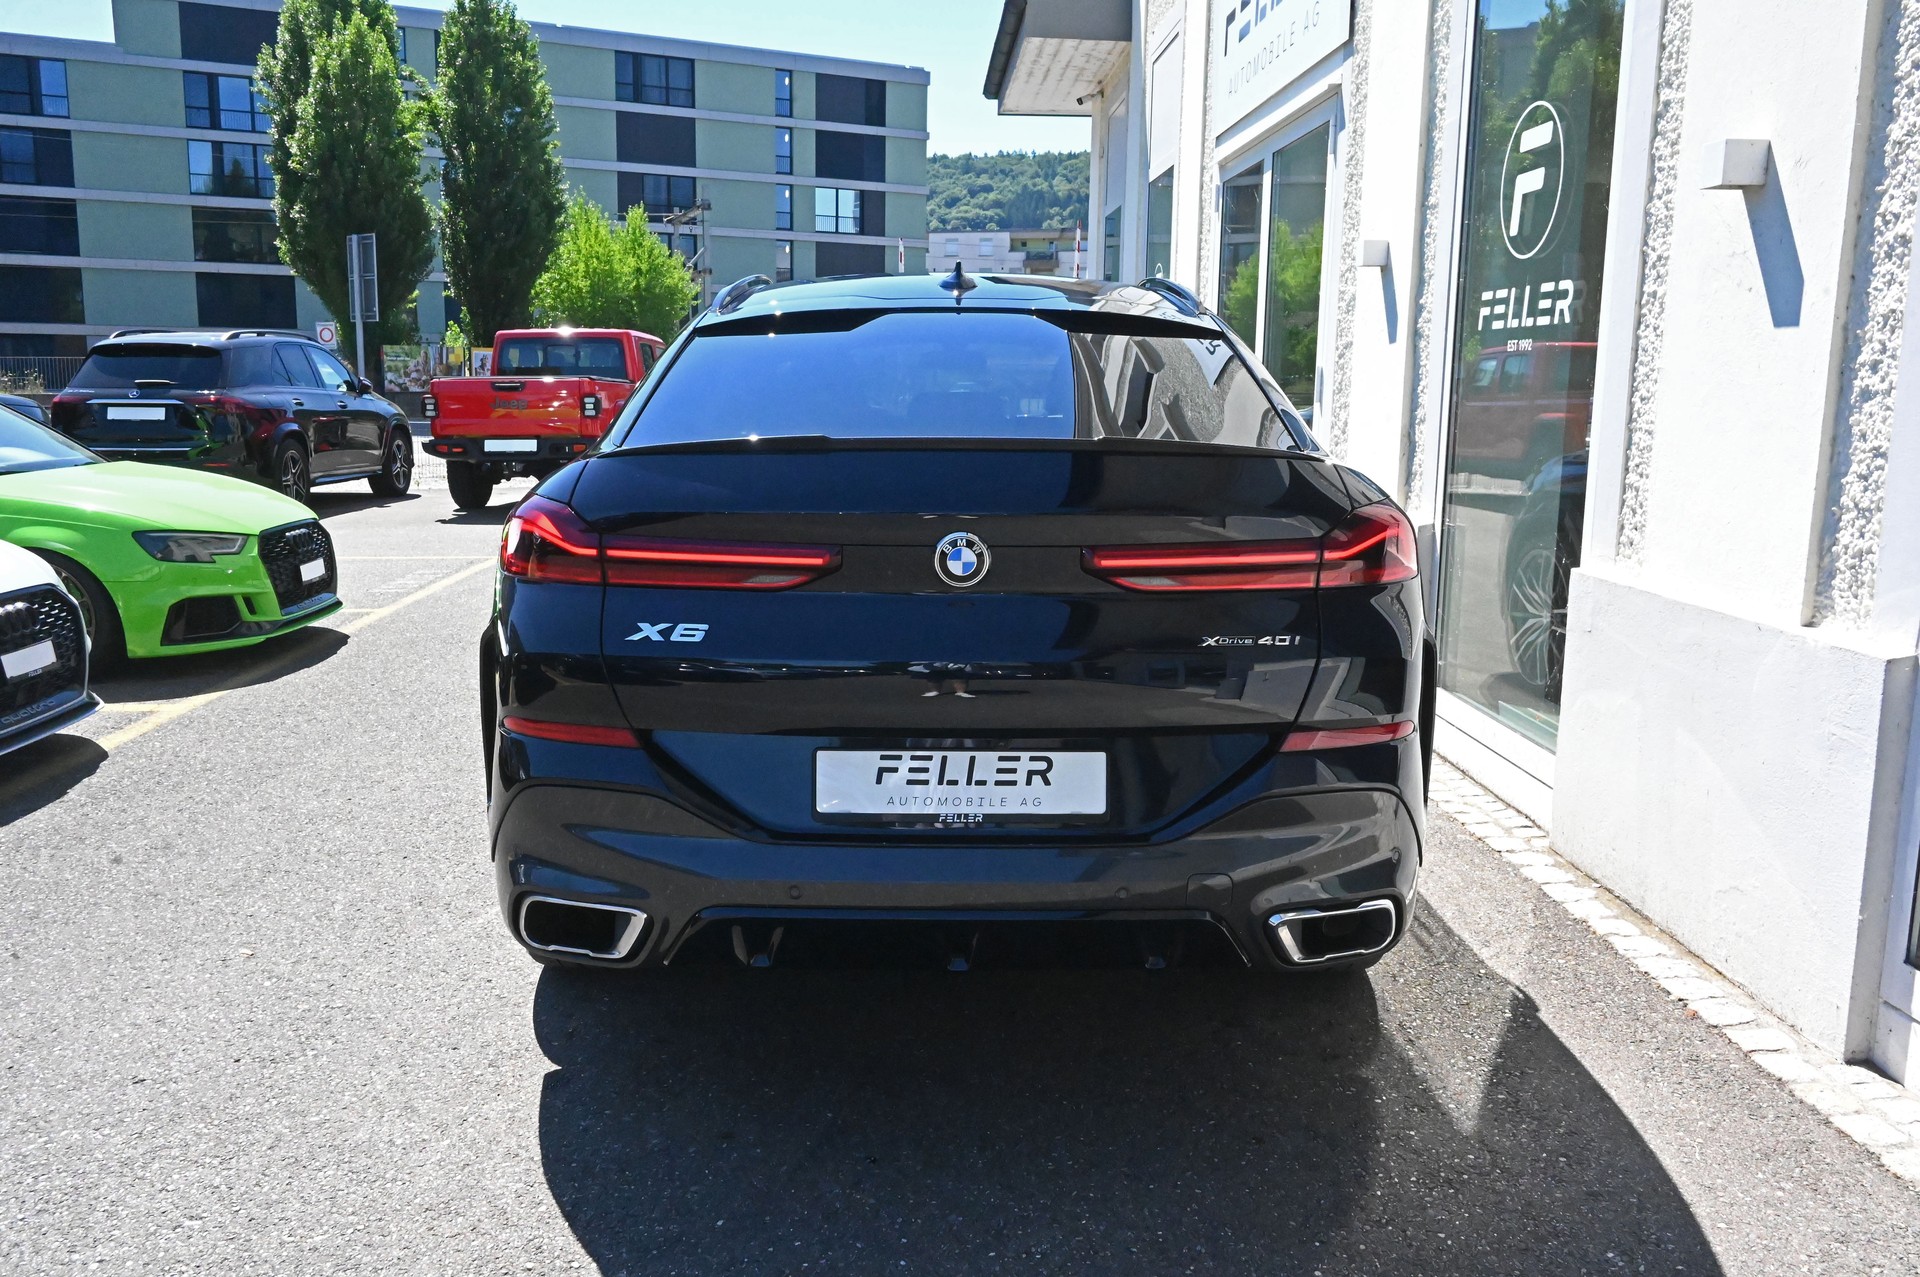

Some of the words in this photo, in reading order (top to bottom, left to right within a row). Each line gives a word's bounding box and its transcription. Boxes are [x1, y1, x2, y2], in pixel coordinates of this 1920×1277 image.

[1228, 21, 1296, 98] AUTOMOBILE
[1303, 1, 1320, 36] AG
[1478, 279, 1574, 331] FELLER
[1507, 339, 1518, 351] EST
[1519, 338, 1532, 351] 1992
[490, 397, 527, 410] Jeep
[942, 538, 982, 554] BMW
[624, 622, 710, 642] X6
[875, 754, 1054, 787] FELLER
[886, 796, 1008, 807] AUTOMOBILE
[1019, 796, 1043, 807] AG
[938, 813, 984, 823] FELLER
